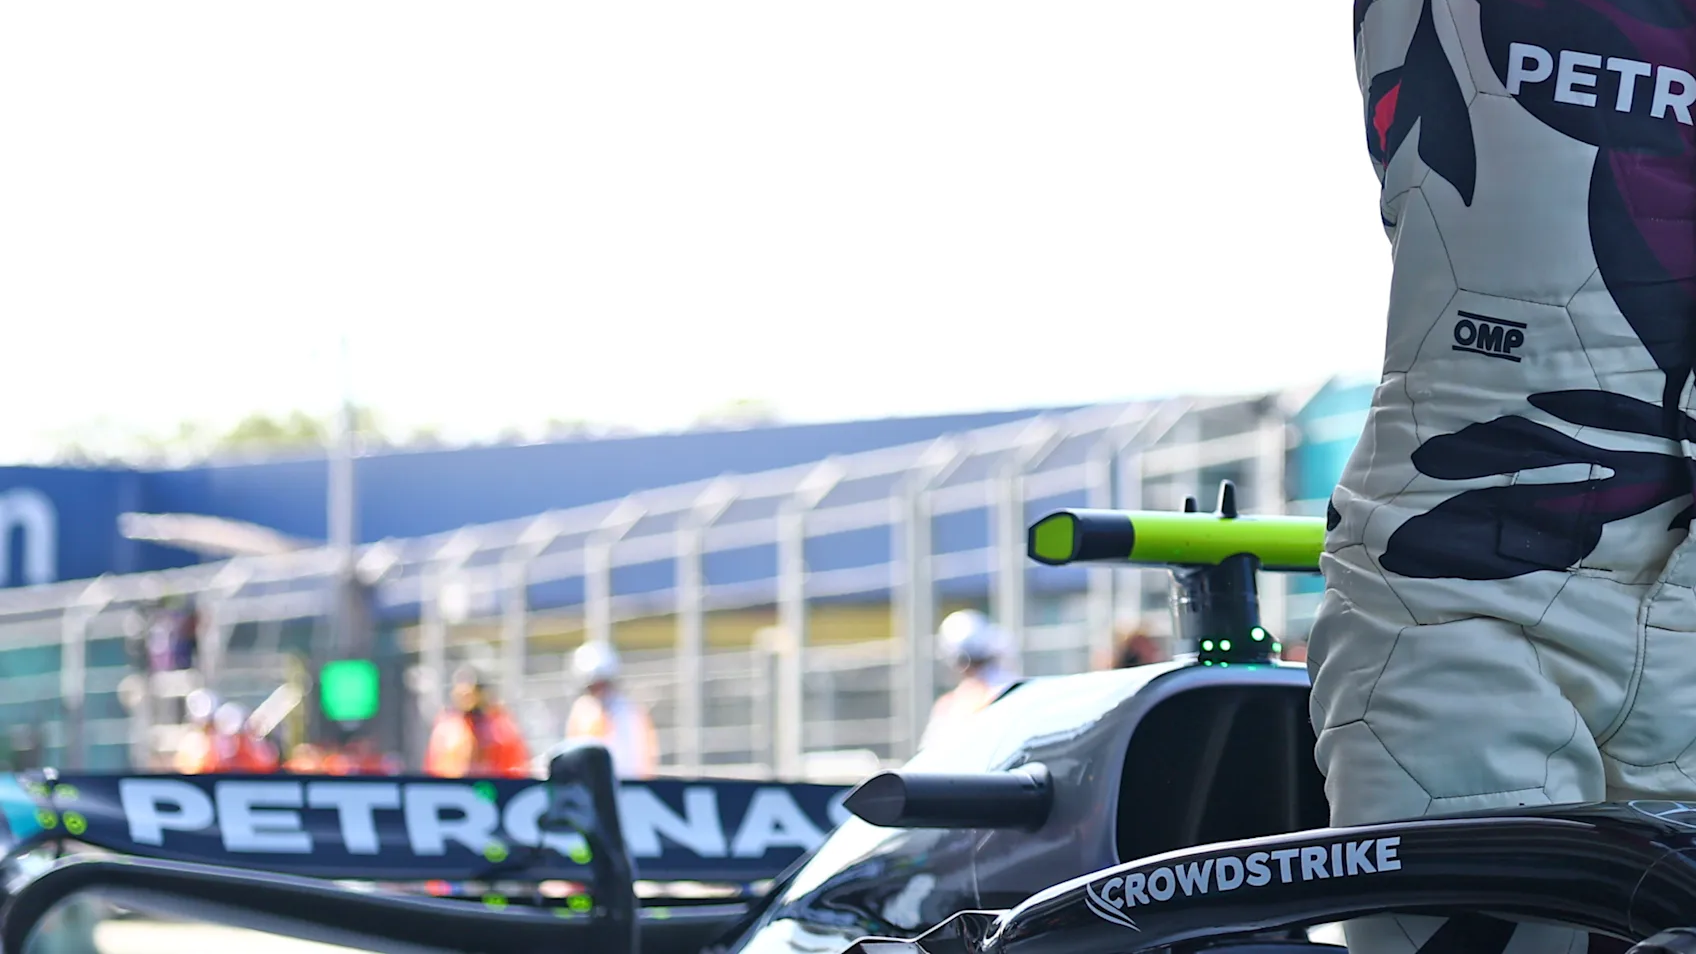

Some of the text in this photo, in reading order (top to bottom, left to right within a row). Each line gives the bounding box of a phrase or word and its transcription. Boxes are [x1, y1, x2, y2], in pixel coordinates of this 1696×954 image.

[1453, 317, 1525, 355] OMP
[119, 778, 846, 859] PETRONA
[1100, 836, 1402, 910] CROWDSTRIKE
